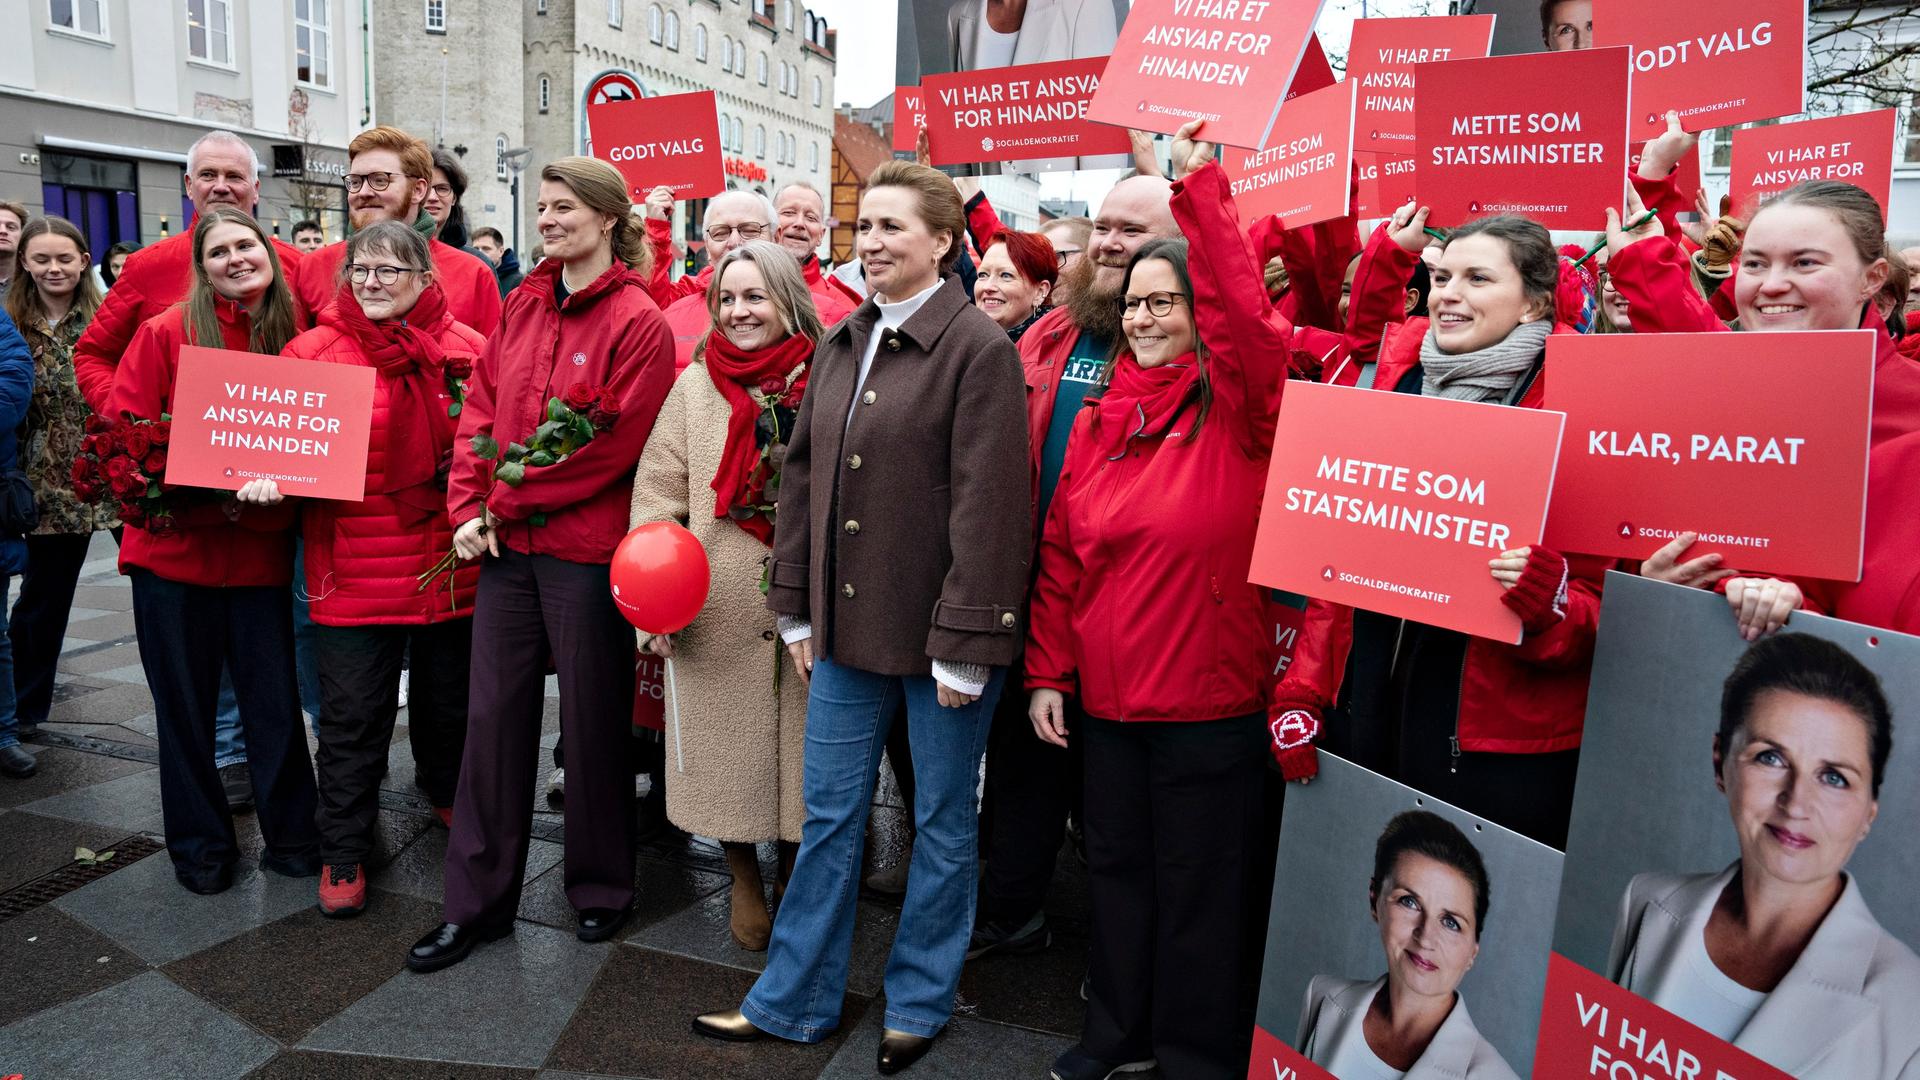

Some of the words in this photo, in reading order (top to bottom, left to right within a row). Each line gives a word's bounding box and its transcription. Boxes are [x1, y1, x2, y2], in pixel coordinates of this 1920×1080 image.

[1173, 0, 1190, 17] VI
[1194, 0, 1241, 20] HAR
[1241, 1, 1270, 22] ET
[1142, 25, 1224, 51] ANSVAR
[1224, 32, 1272, 56] FOR
[1630, 40, 1692, 73] ODT
[1697, 22, 1772, 58] VALG
[1379, 48, 1393, 64] VI
[1396, 48, 1429, 64] HAR
[1138, 55, 1250, 87] HINANDEN
[939, 88, 959, 107] VI
[963, 83, 1004, 105] HAR
[1009, 81, 1030, 100] ET
[1035, 74, 1100, 99] ANSVA
[905, 96, 919, 111] VI
[954, 107, 992, 128] FOR
[997, 99, 1091, 125] HINANDE
[1148, 104, 1221, 122] SOCIALDEMOKRATIET
[1365, 96, 1415, 112] HINAN
[1451, 114, 1521, 136] METTE
[1527, 111, 1581, 134] SOM
[996, 134, 1080, 148] SOCIALDEMOKRATIET
[1380, 132, 1416, 141] SOCIALDEMO
[609, 143, 656, 162] GODT
[659, 138, 704, 156] VALG
[1243, 144, 1287, 171] METTE
[1290, 131, 1323, 156] SOM
[1432, 143, 1604, 166] STATSMINISTER
[1767, 150, 1784, 165] VI
[1788, 145, 1826, 163] HAR
[1830, 142, 1852, 158] ET
[305, 159, 346, 177] ESSAGE
[1230, 152, 1335, 196] STATSMINISTER
[1358, 165, 1378, 180] LG
[1384, 159, 1416, 176] STATS
[1752, 166, 1822, 187] ANSVAR
[1826, 161, 1864, 179] FOR
[1482, 204, 1568, 213] SOCIALDEMOKRATIET
[224, 382, 246, 400] VI
[252, 385, 298, 405] HAR
[303, 391, 328, 409] ET
[202, 405, 292, 429] ANSVAR
[297, 415, 340, 434] FOR
[210, 430, 329, 457] HINANDEN
[1588, 430, 1681, 465] KLAR,
[1689, 434, 1805, 465] PARAT
[237, 470, 318, 484] SOCIALDEMOKRATIET
[1316, 455, 1411, 493] METTE
[1415, 471, 1485, 506] SOM
[1285, 487, 1511, 550] STATSMINISTER
[1639, 527, 1770, 549] SOCIALMOKRATIET
[1339, 572, 1451, 604] SOCIALDEMOKRATIET
[1275, 622, 1297, 650] VI
[640, 680, 664, 700] FO
[1575, 992, 1609, 1038] VI
[1618, 1017, 1702, 1080] HAR
[1589, 1044, 1656, 1080] FO
